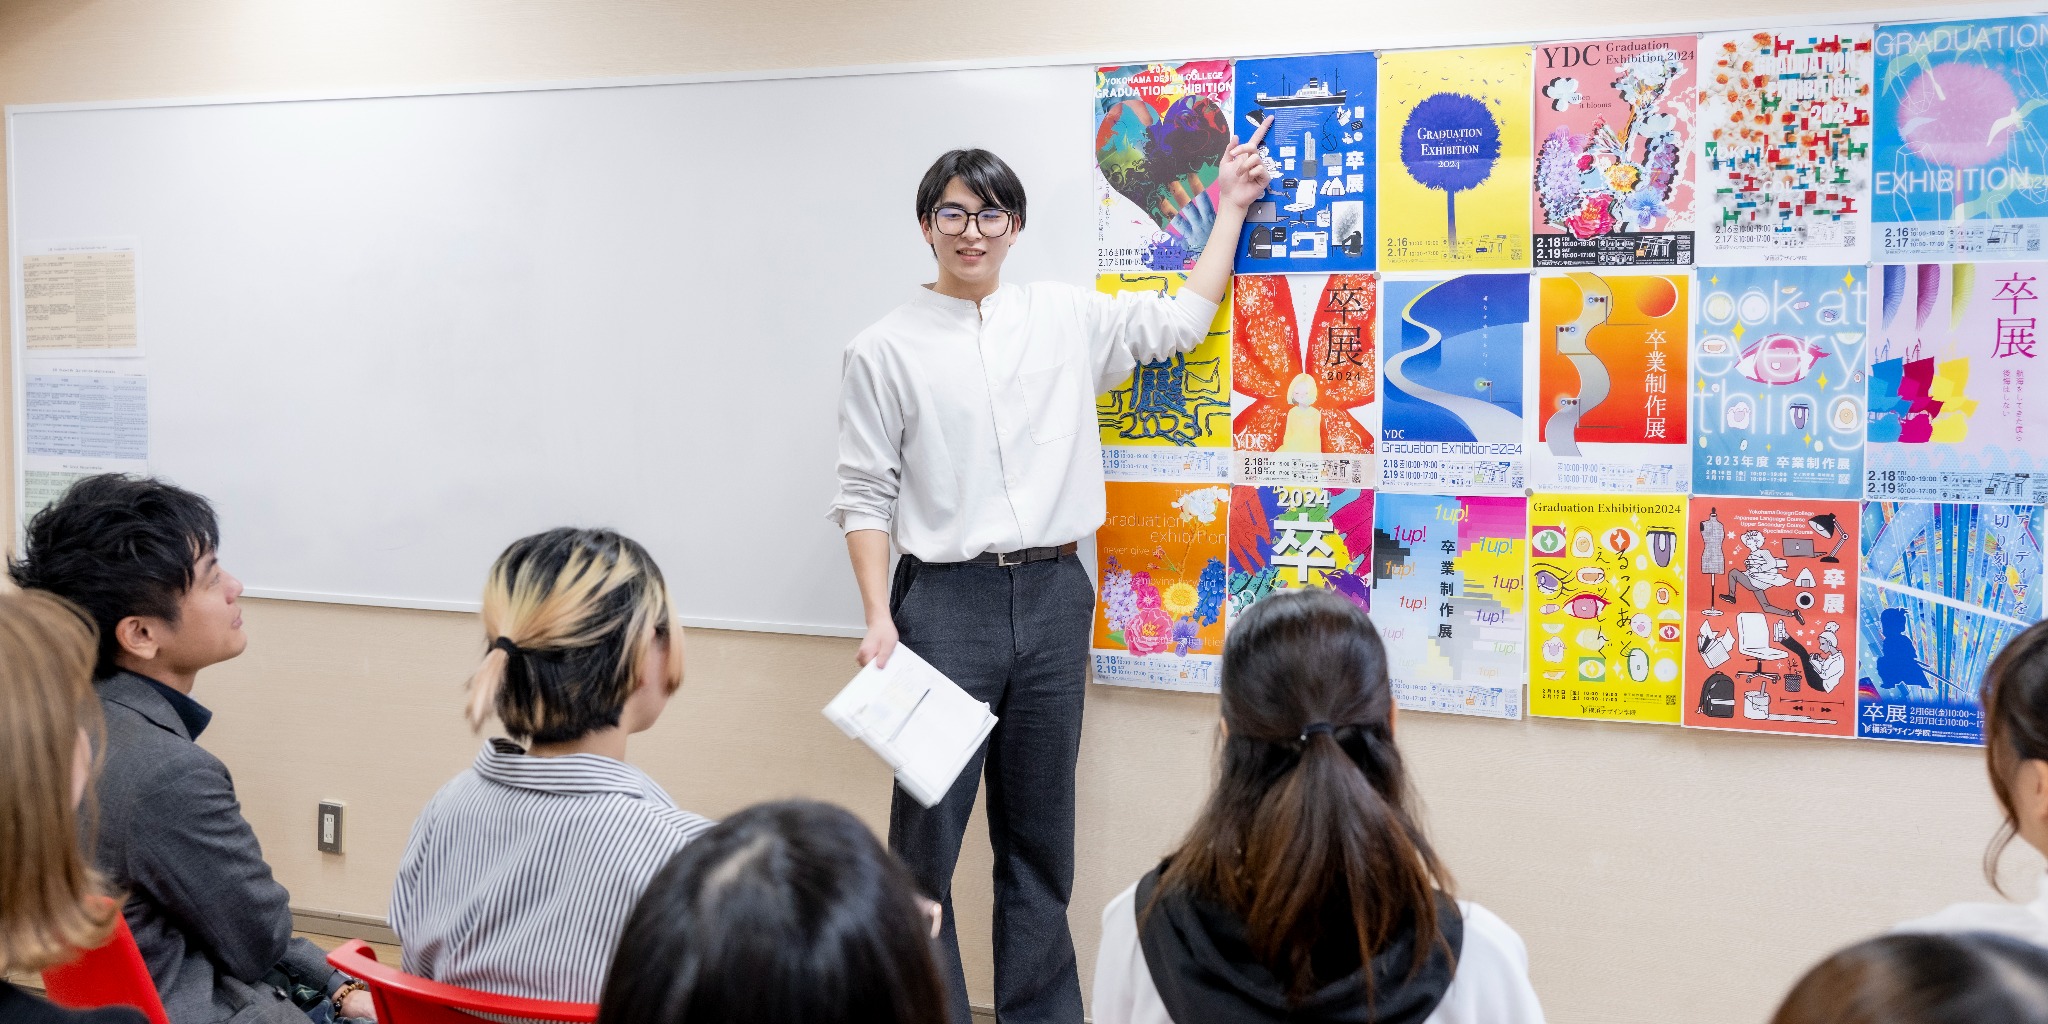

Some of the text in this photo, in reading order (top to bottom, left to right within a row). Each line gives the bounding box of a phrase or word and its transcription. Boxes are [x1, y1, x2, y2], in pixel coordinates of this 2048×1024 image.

[1542, 41, 1669, 68] YDC Graduation
[1606, 50, 1694, 64] Exhibition 2024
[1150, 65, 1171, 73] 2024
[1105, 75, 1151, 86] YOKOHAMA
[1810, 104, 1857, 124] 2024
[1417, 127, 1483, 140] GRADUATION
[1421, 144, 1480, 156] EXHIBITION
[1437, 160, 1461, 169] 2024
[1345, 150, 1365, 193] 卒展
[1876, 166, 2028, 195] EXHIBITION
[1715, 225, 1732, 234] 2.16
[1885, 227, 1909, 237] 2.16
[1387, 238, 1408, 246] 2.16
[1536, 238, 1560, 248] 2.18
[1714, 235, 1732, 243] 2.17
[1885, 238, 1909, 248] 2.17
[1098, 248, 1114, 256] 2.16
[1387, 248, 1408, 257] 2.17
[1536, 248, 1560, 259] 2.19
[1098, 258, 1114, 267] 2.17
[1695, 279, 1868, 326] look at
[1991, 271, 2039, 359] 卒展
[1323, 283, 1365, 368] 卒展
[1695, 333, 1868, 391] every
[1327, 371, 1361, 382] 2024
[1644, 328, 1668, 439] 卒業制作展
[1693, 376, 1868, 451] thing
[1232, 433, 1269, 450] YDC
[1384, 430, 1405, 440] YDC
[1382, 442, 1438, 454] Graduation
[1244, 458, 1263, 466] 2.18
[1384, 460, 1398, 468] 2.18
[1706, 455, 1850, 470] 2023年度 卒業制作展
[1244, 466, 1263, 475] 2.19
[1384, 470, 1398, 478] 2.19
[1868, 470, 1896, 482] 2.18
[1868, 483, 1896, 494] 2.19
[1276, 487, 1331, 508] 2024
[1534, 502, 1594, 512] Graduation
[1434, 504, 1469, 526] 1up!
[1394, 525, 1427, 546] 1up!
[1104, 546, 1128, 554] never
[1130, 546, 1150, 558] give
[1271, 513, 1336, 582] 卒
[1480, 536, 1514, 558] 1up!
[1994, 514, 2010, 583] 切り刻め
[1385, 560, 1416, 580] 1up!
[2014, 514, 2030, 615] アイディアを
[1438, 539, 1456, 639] 卒業制作展
[1492, 574, 1524, 592] 1up!
[1822, 568, 1846, 614] 卒展
[1400, 595, 1427, 612] 1up!
[1476, 608, 1504, 626] 1up!
[1382, 627, 1405, 641] 1up!
[1494, 642, 1516, 656] 1up!
[1096, 655, 1116, 665] 2.18
[1097, 664, 1117, 674] 2.19
[1862, 702, 1908, 724] 卒展
[1872, 725, 1931, 737] 横浜デザイン学院
